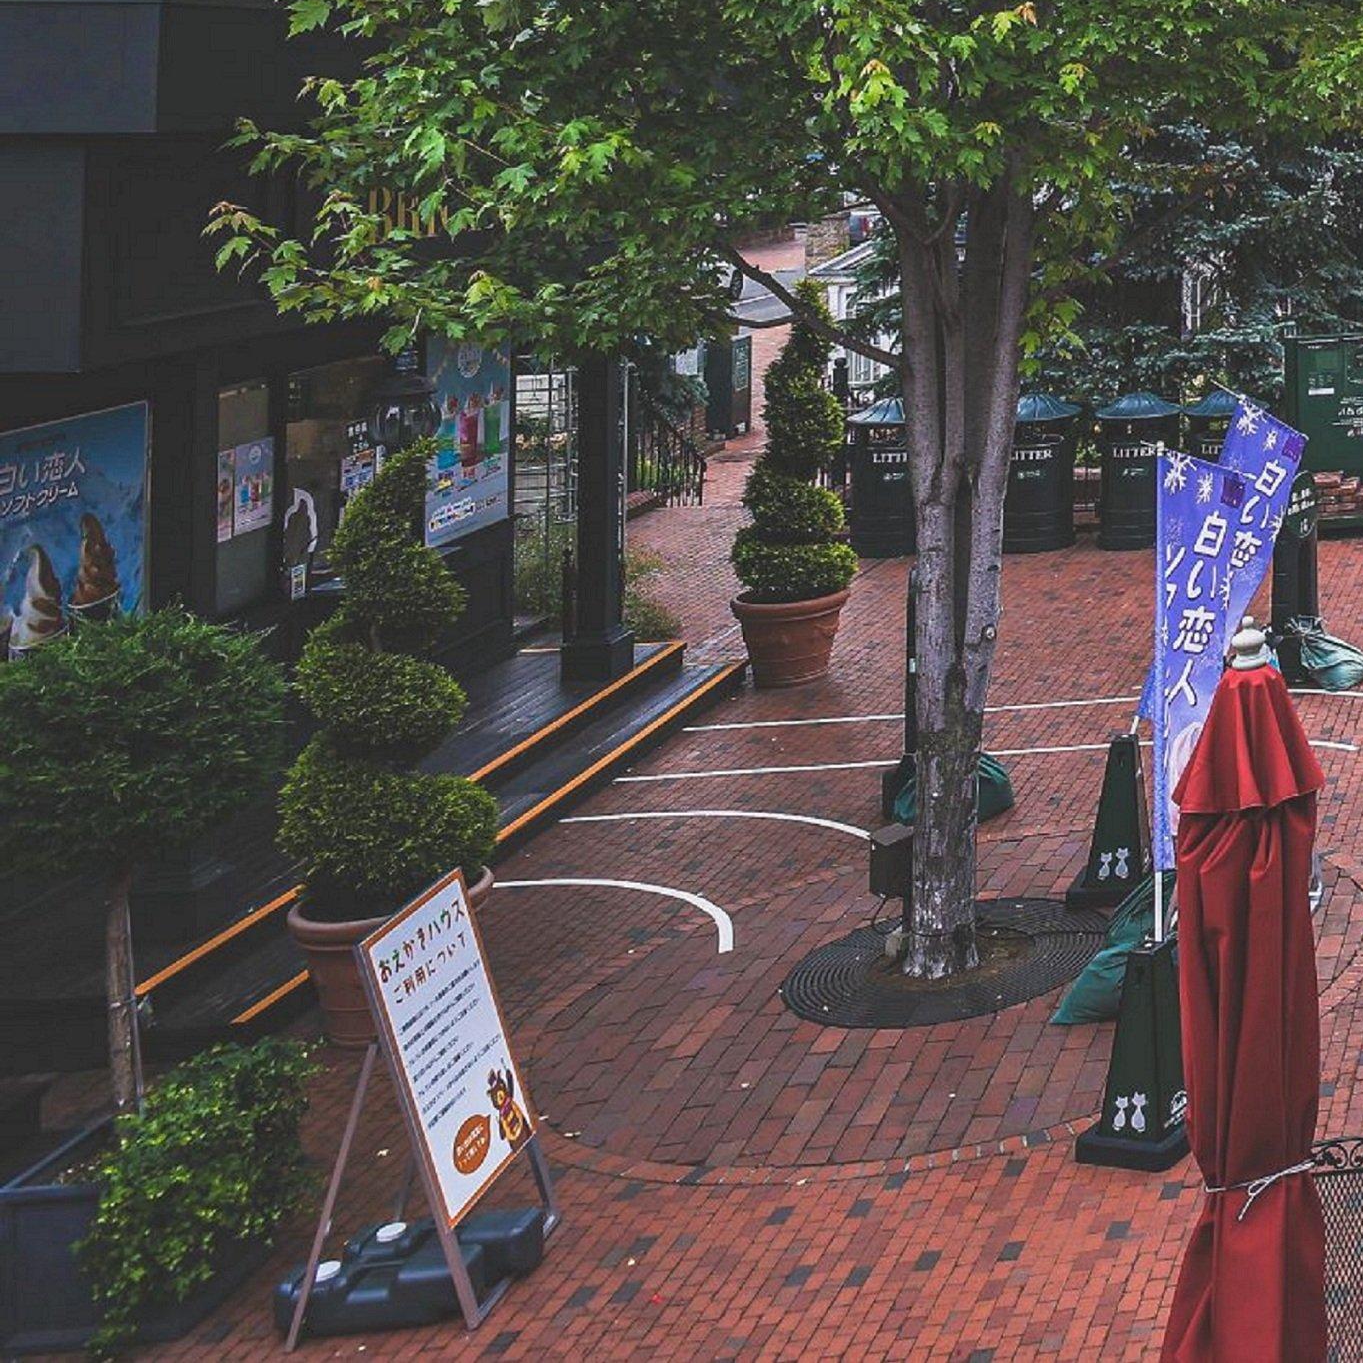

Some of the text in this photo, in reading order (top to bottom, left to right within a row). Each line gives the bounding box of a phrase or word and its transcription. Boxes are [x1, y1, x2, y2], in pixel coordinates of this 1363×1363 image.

[873, 452, 908, 463] LITT
[1201, 443, 1223, 455] LIT
[1230, 459, 1287, 570] 白い恋
[1167, 510, 1228, 706] 白い恋人
[378, 898, 465, 984] おえかきハウス
[393, 931, 466, 1004] ご利用について
